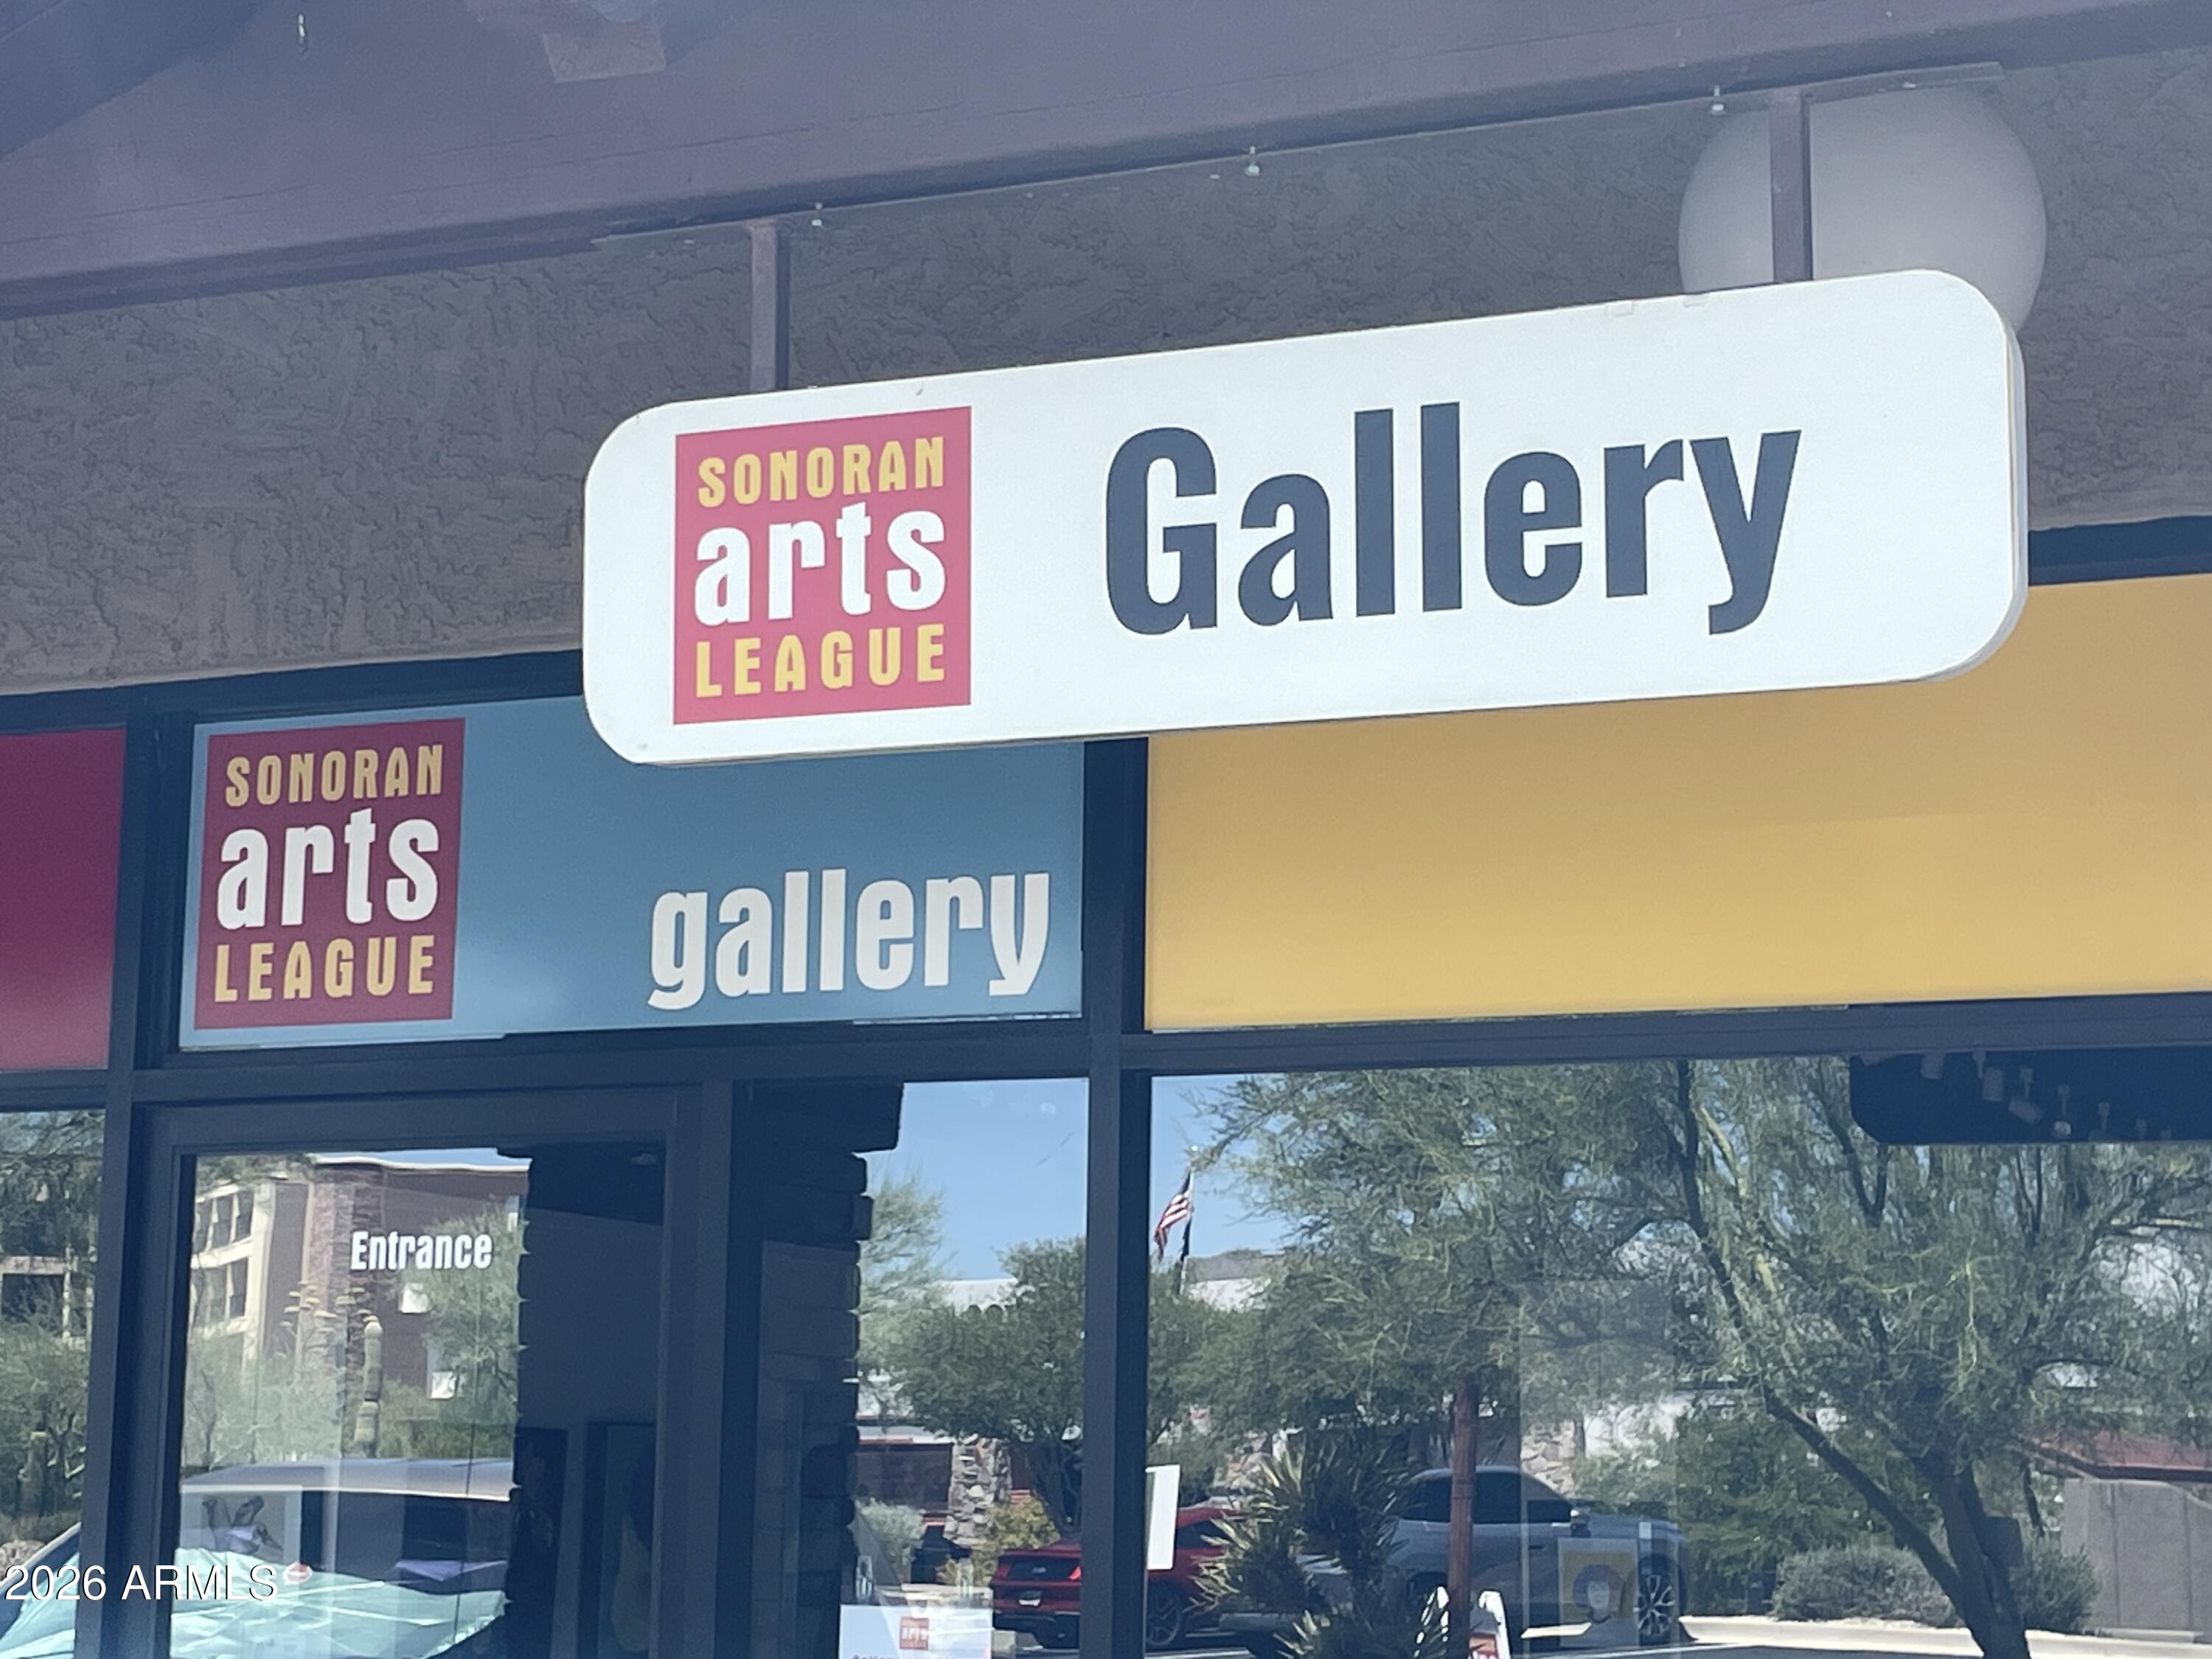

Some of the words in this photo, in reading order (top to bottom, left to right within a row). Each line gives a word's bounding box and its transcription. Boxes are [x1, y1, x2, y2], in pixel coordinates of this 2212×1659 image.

[698, 437, 943, 507] SONORAN
[1105, 401, 1802, 636] Gallery
[695, 501, 946, 626] arts
[696, 624, 945, 698] LEAGUE
[225, 744, 442, 807] SONORAN
[217, 807, 439, 930] arts
[215, 935, 434, 1002] LEAGUE
[647, 869, 1049, 1011] gallery
[350, 1231, 493, 1270] Entrance
